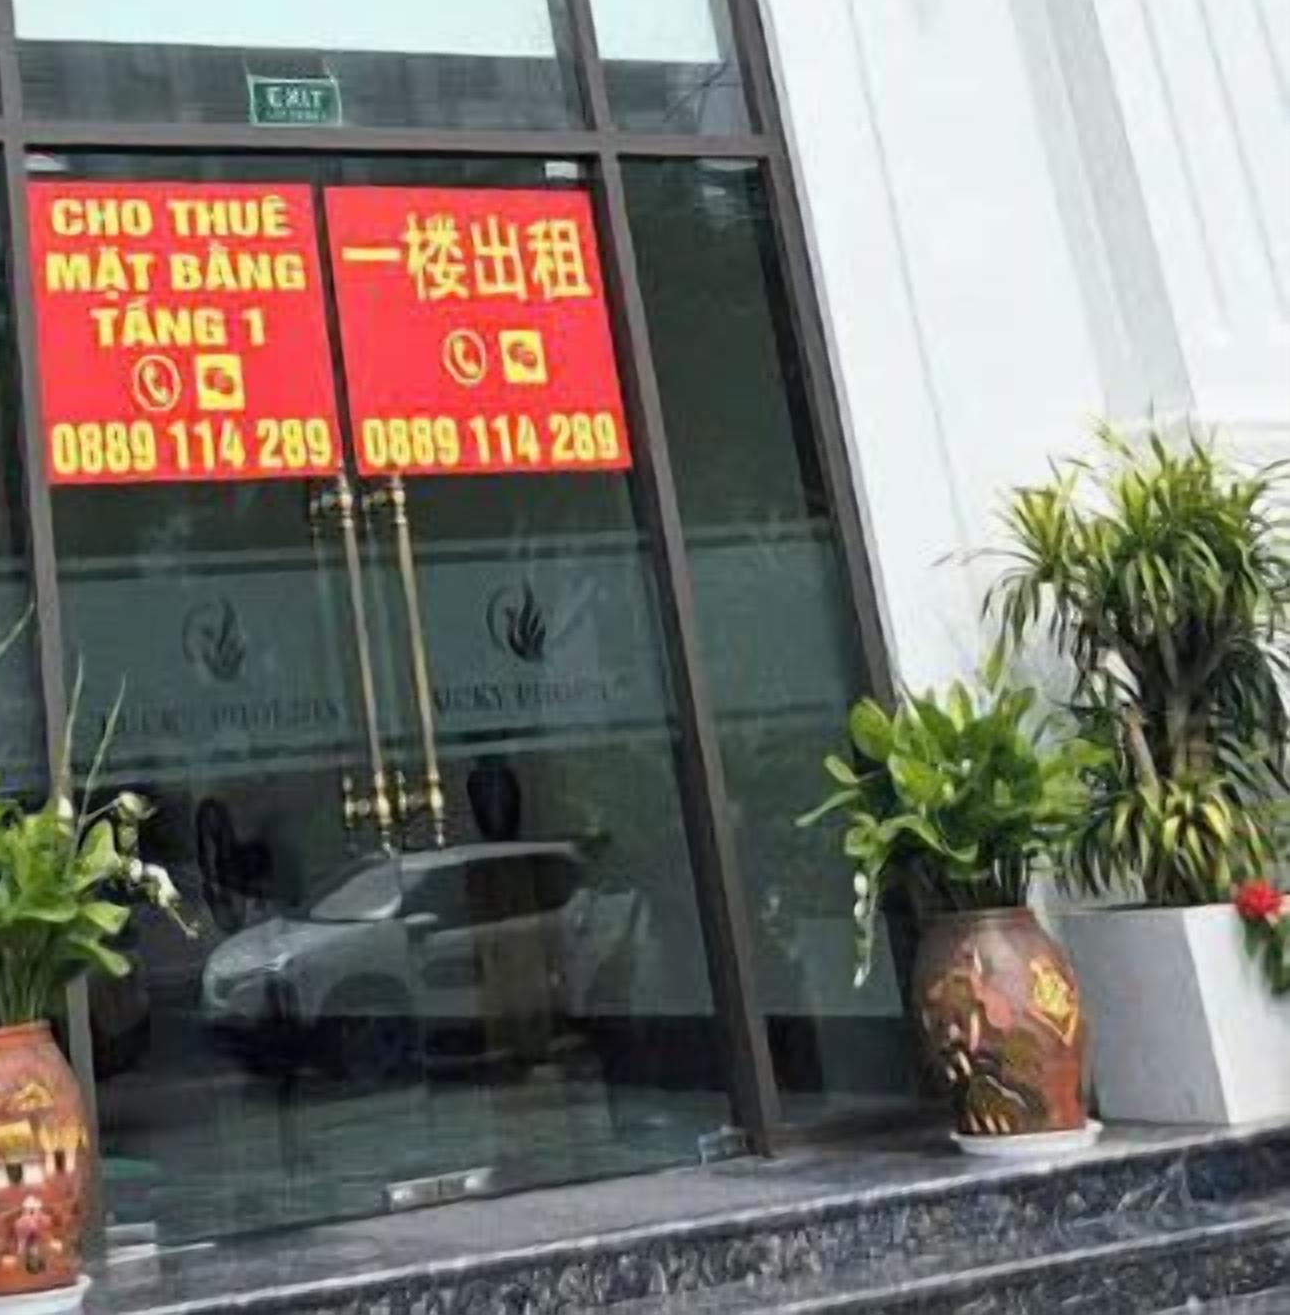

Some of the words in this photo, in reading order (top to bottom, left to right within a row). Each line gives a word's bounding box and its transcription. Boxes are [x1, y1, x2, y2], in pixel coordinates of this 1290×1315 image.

[51, 199, 153, 237] CHO
[167, 195, 292, 238] THUÊ
[341, 213, 593, 302] 一楼出租
[241, 307, 266, 345] 1
[51, 419, 157, 475] 0889
[168, 419, 247, 470] 114
[256, 417, 334, 469] 289
[361, 416, 461, 469] 0889
[468, 414, 541, 463] 114
[548, 412, 620, 462] 289
